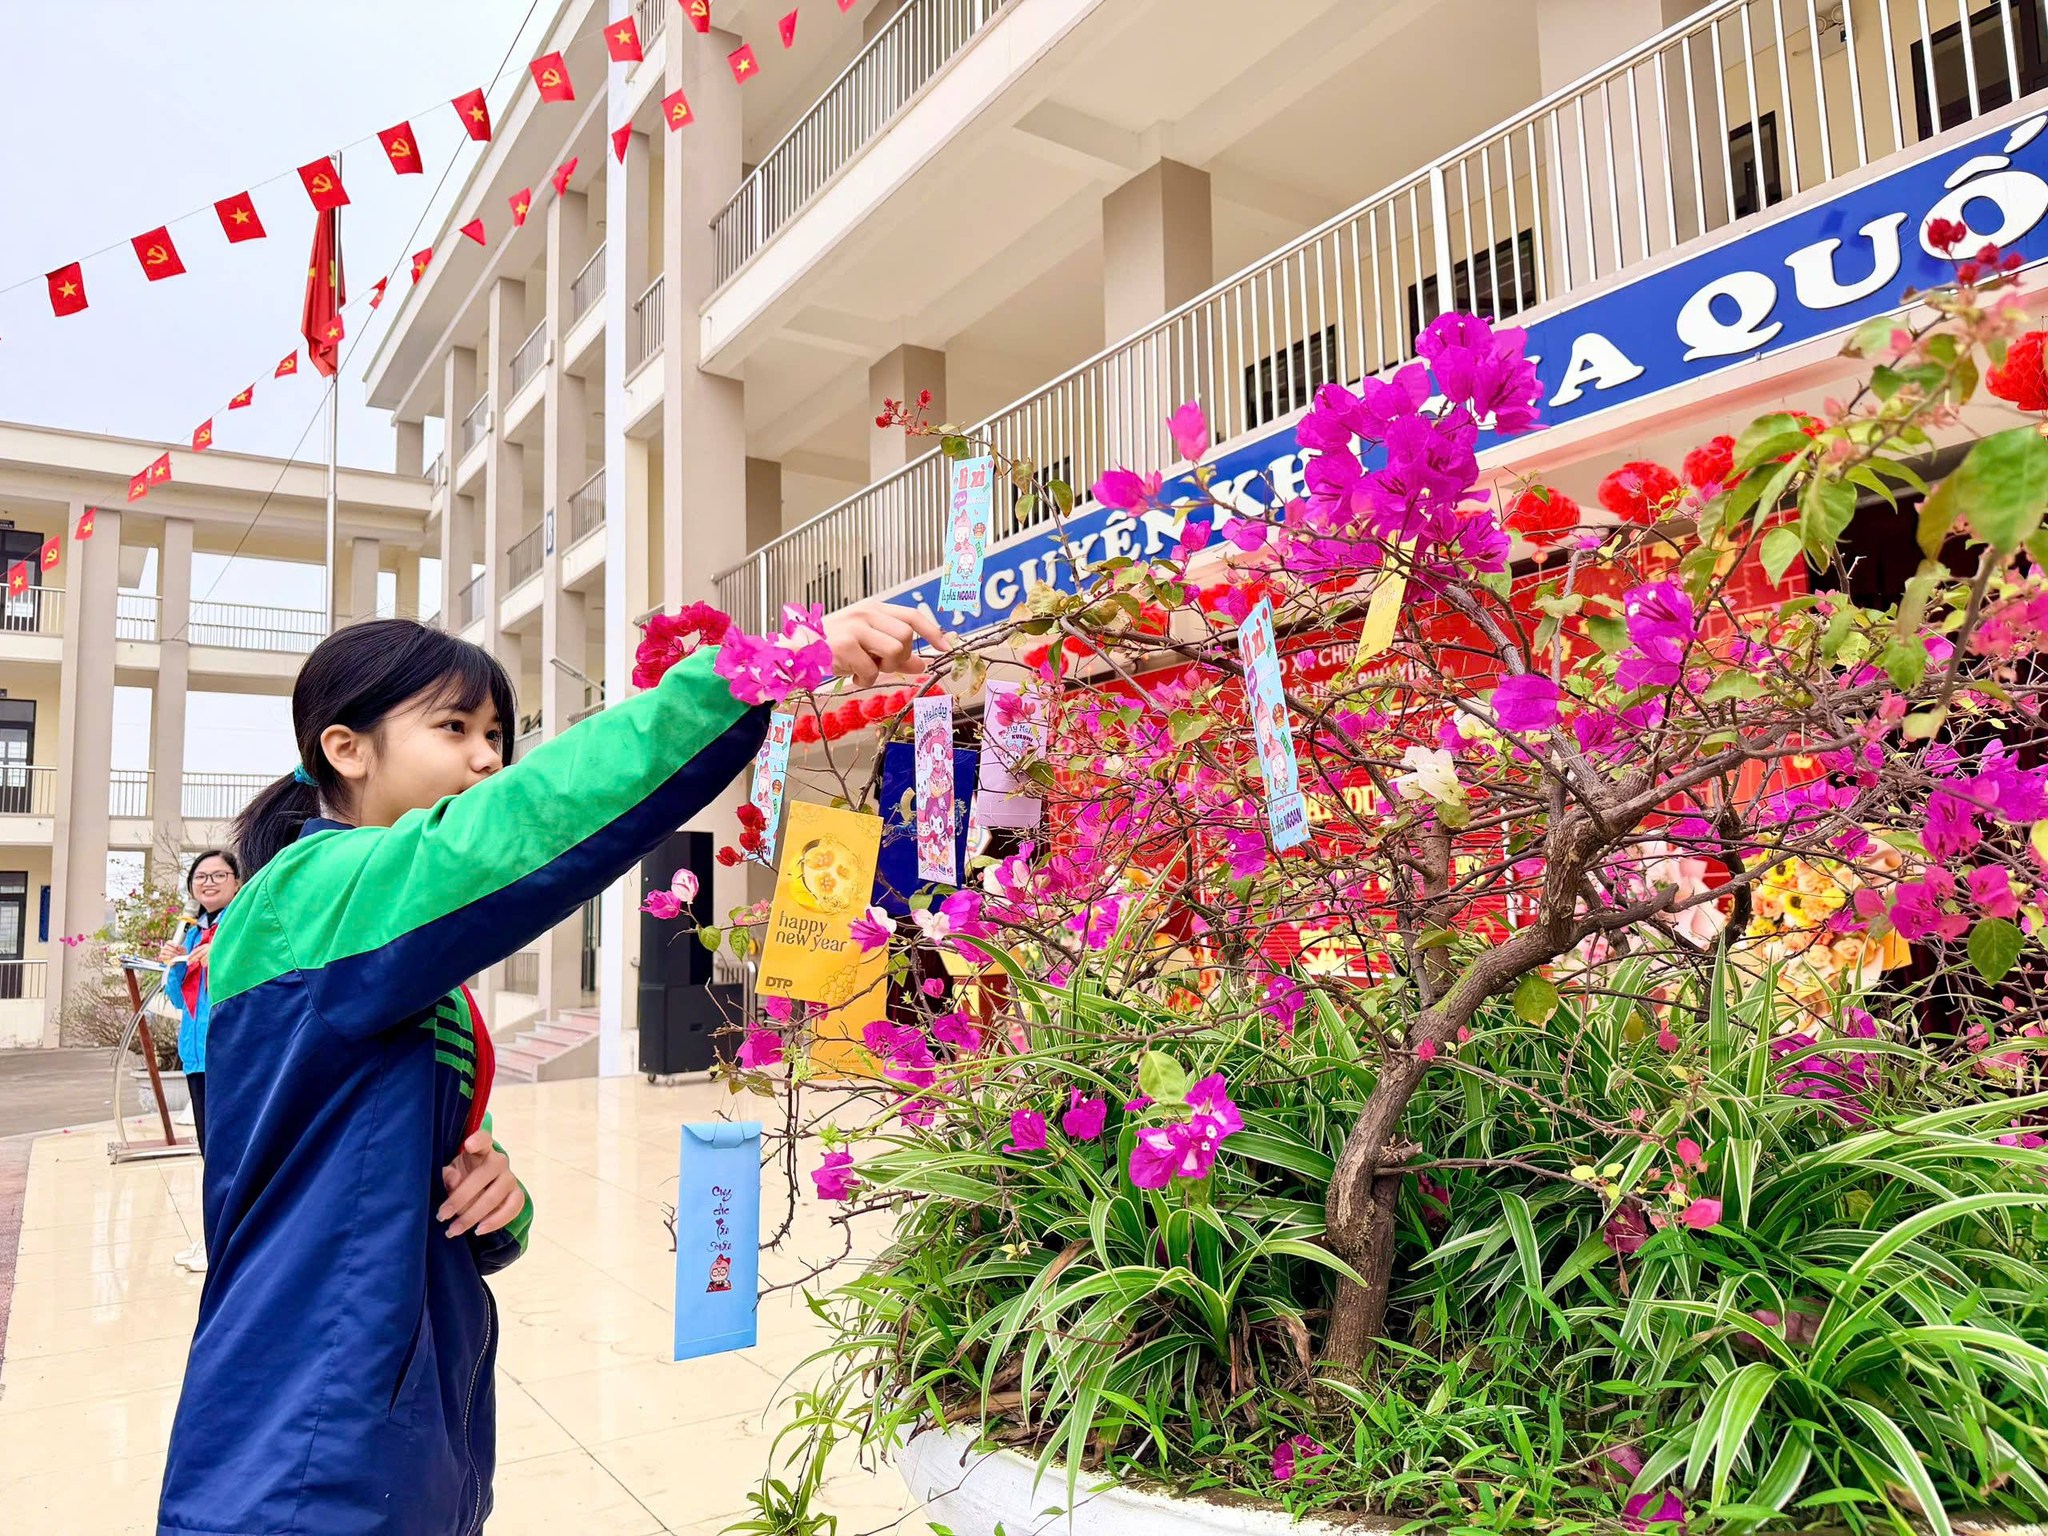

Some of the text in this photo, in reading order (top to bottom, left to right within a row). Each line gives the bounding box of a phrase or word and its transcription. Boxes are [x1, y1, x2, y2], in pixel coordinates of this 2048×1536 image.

[951, 496, 1190, 626] GUYÊN
[1208, 431, 1369, 531] KH
[778, 910, 828, 937] happy
[776, 930, 848, 952] new year
[765, 976, 793, 990] DTP
